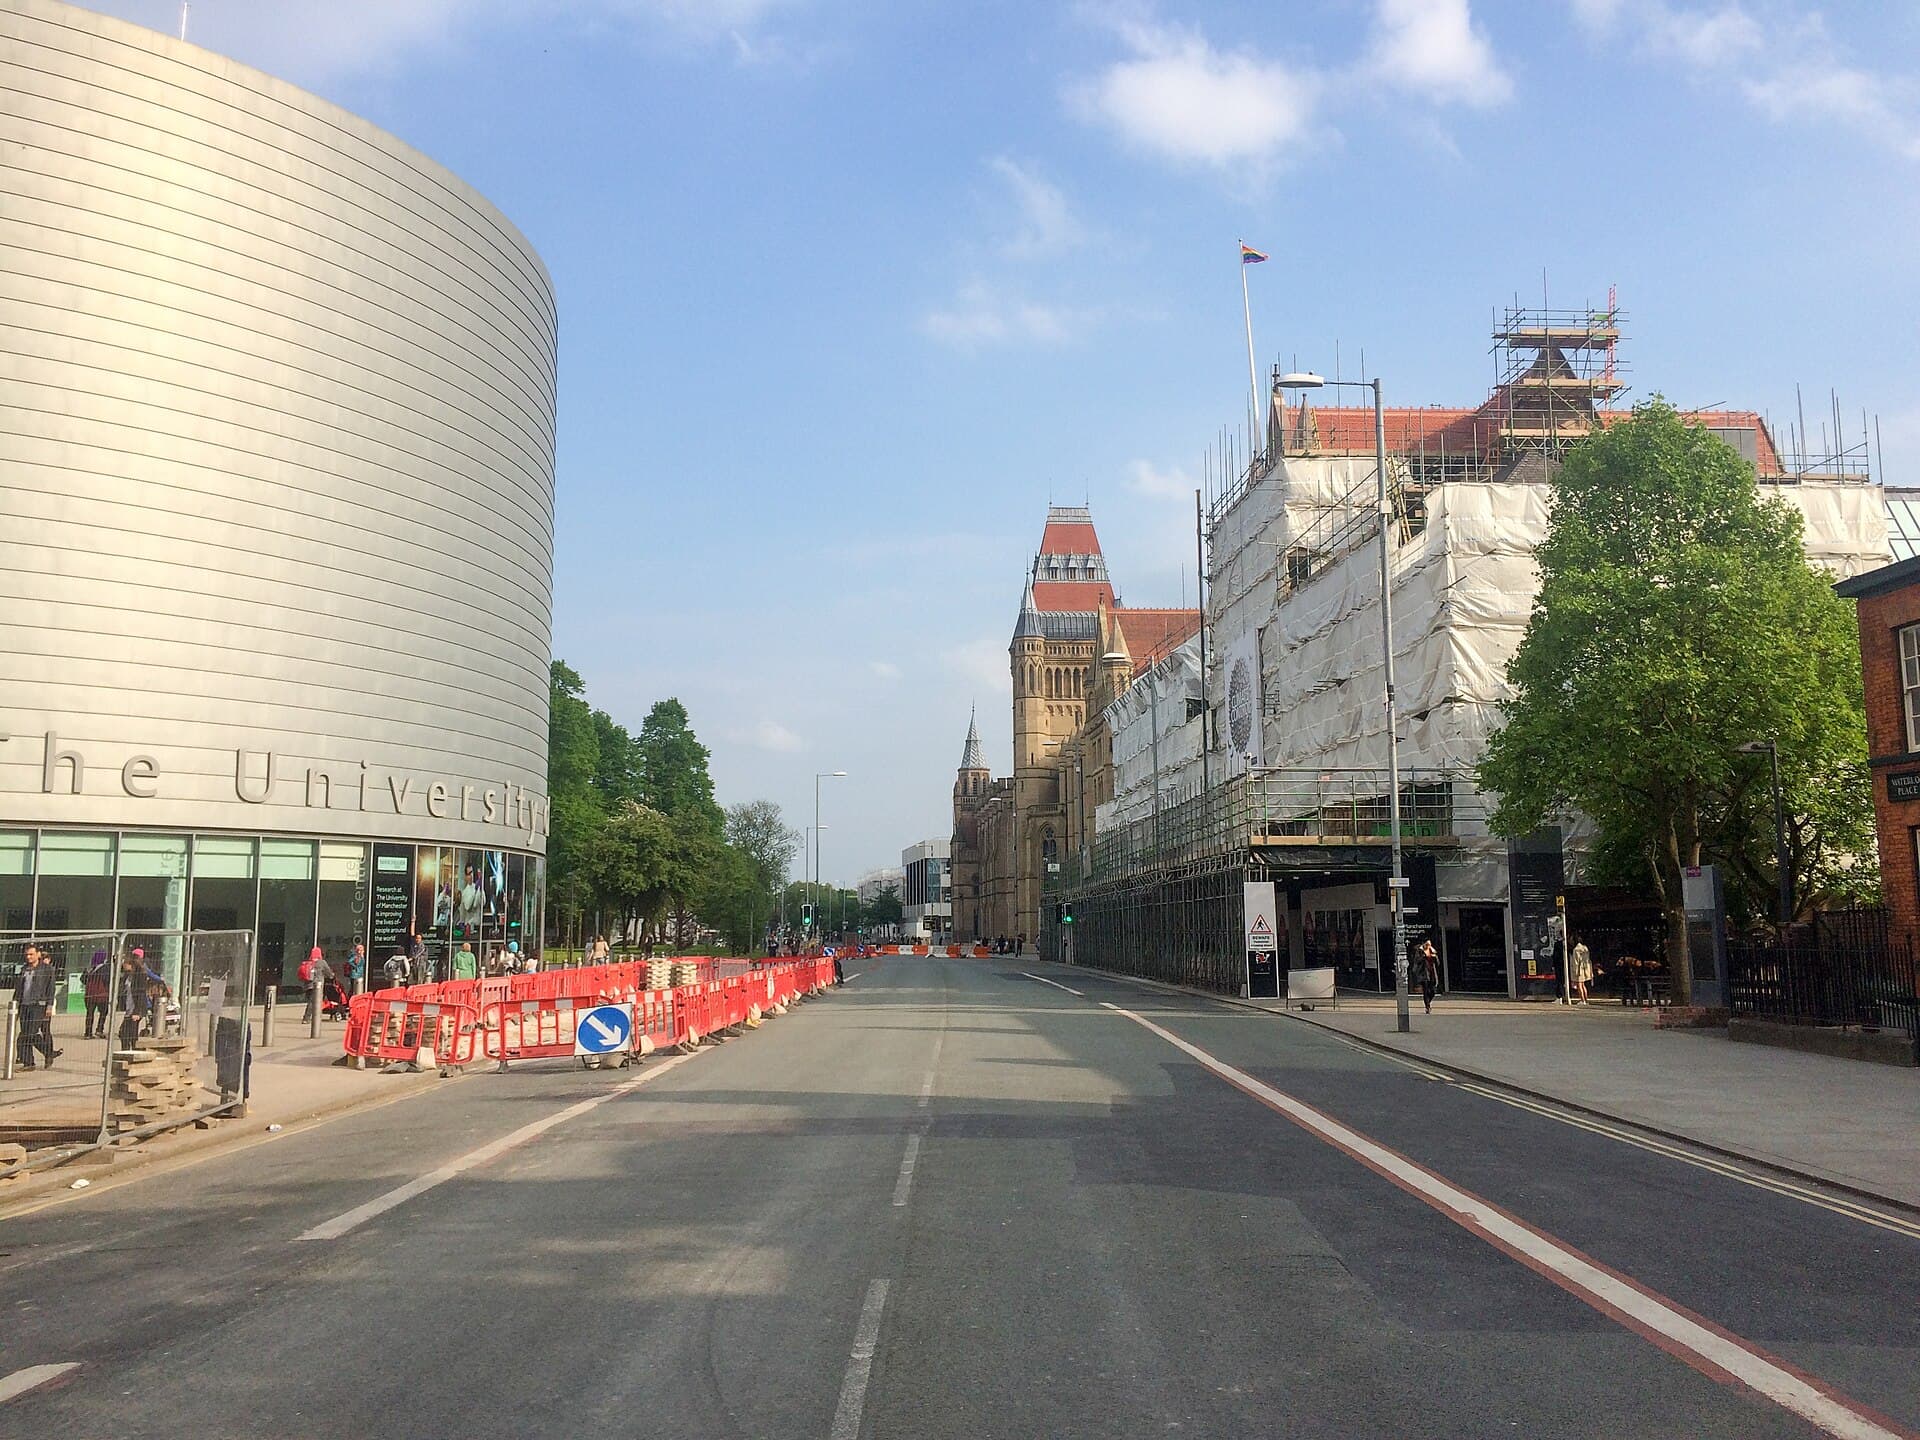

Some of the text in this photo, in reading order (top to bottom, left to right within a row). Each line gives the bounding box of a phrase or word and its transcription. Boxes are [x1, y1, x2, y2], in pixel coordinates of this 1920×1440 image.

[0, 731, 160, 798] he
[235, 748, 538, 847] University
[1897, 785, 1919, 796] PLACE
[386, 895, 408, 903] University
